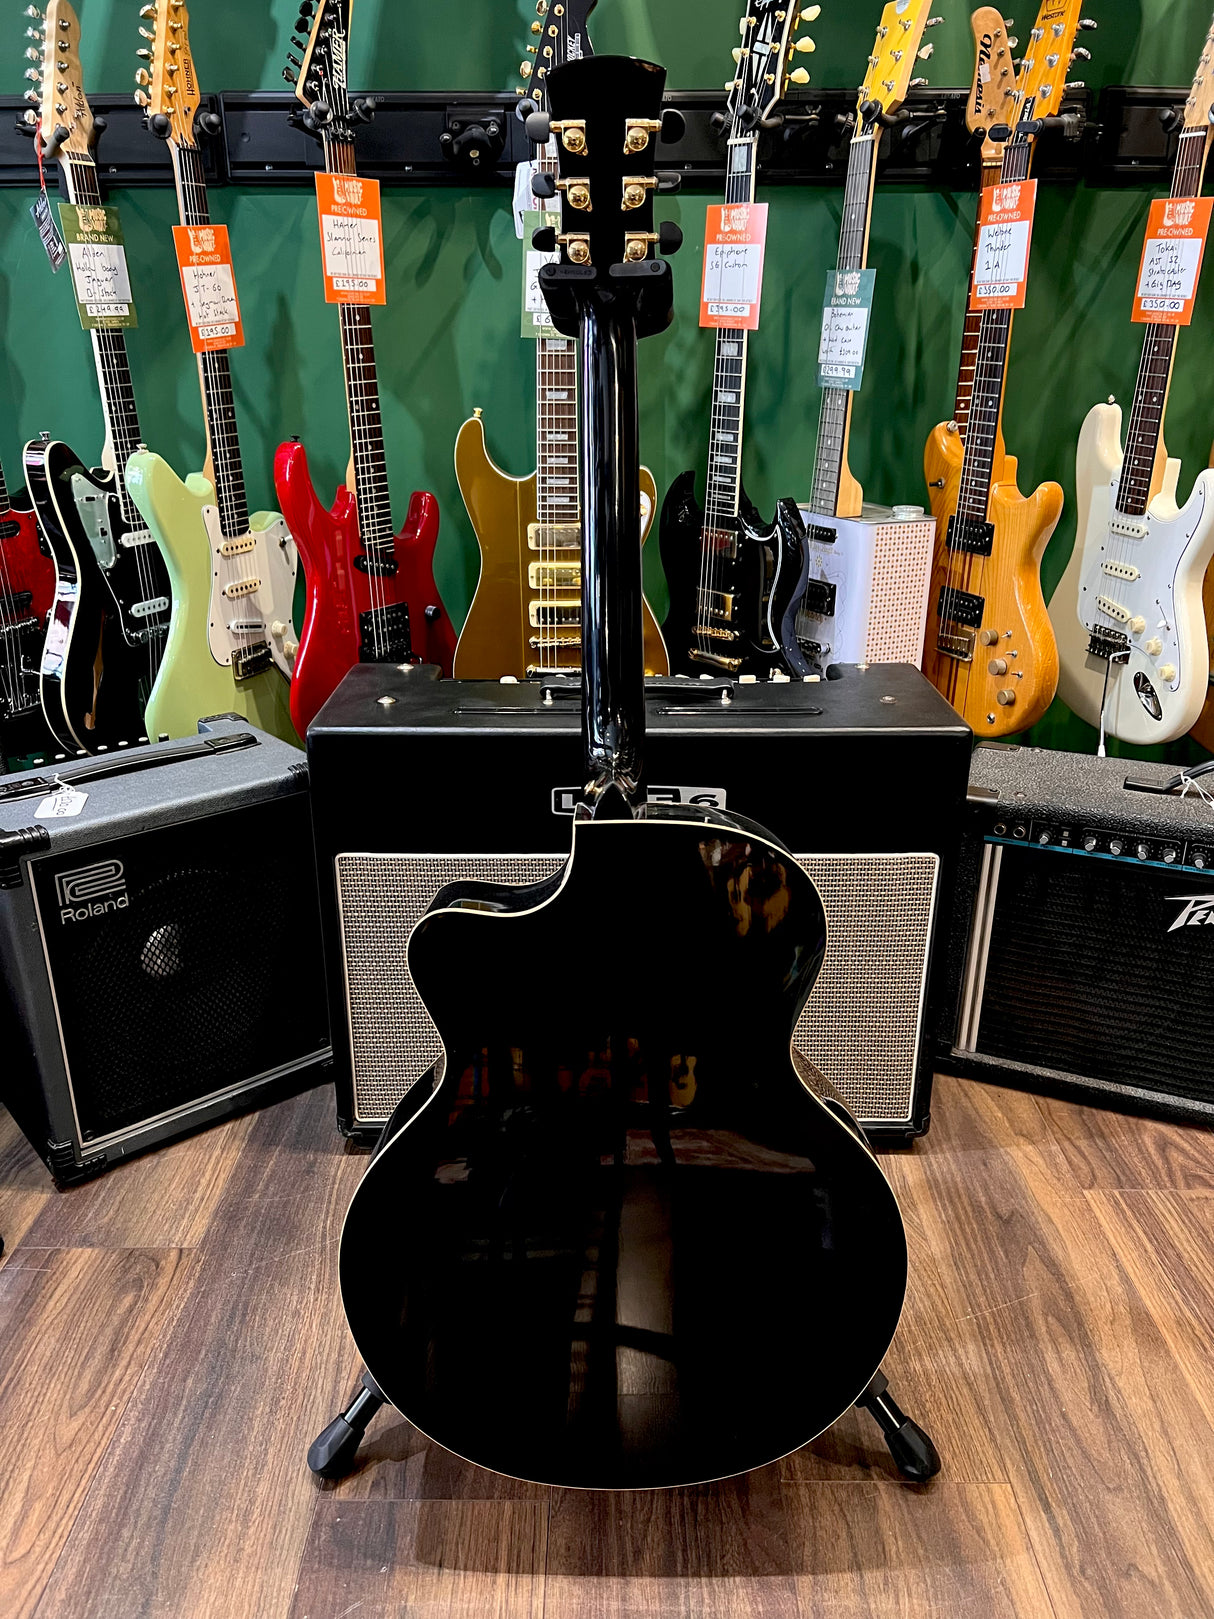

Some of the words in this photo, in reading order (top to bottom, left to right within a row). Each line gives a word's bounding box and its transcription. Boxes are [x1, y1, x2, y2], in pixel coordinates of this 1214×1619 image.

[332, 28, 346, 89] HAMER
[183, 58, 196, 96] HOHNER
[331, 205, 367, 216] PRE-OWNED
[987, 211, 1021, 221] PRE-OWNED
[1157, 228, 1193, 236] PRE-OWNED
[76, 233, 98, 242] BRAND
[100, 234, 113, 242] NEW
[716, 233, 751, 242] PRE-OWNED
[189, 254, 221, 263] PRE-OWNED
[848, 297, 861, 305] NEW
[1143, 300, 1180, 309] £350.00
[61, 892, 129, 924] Roland
